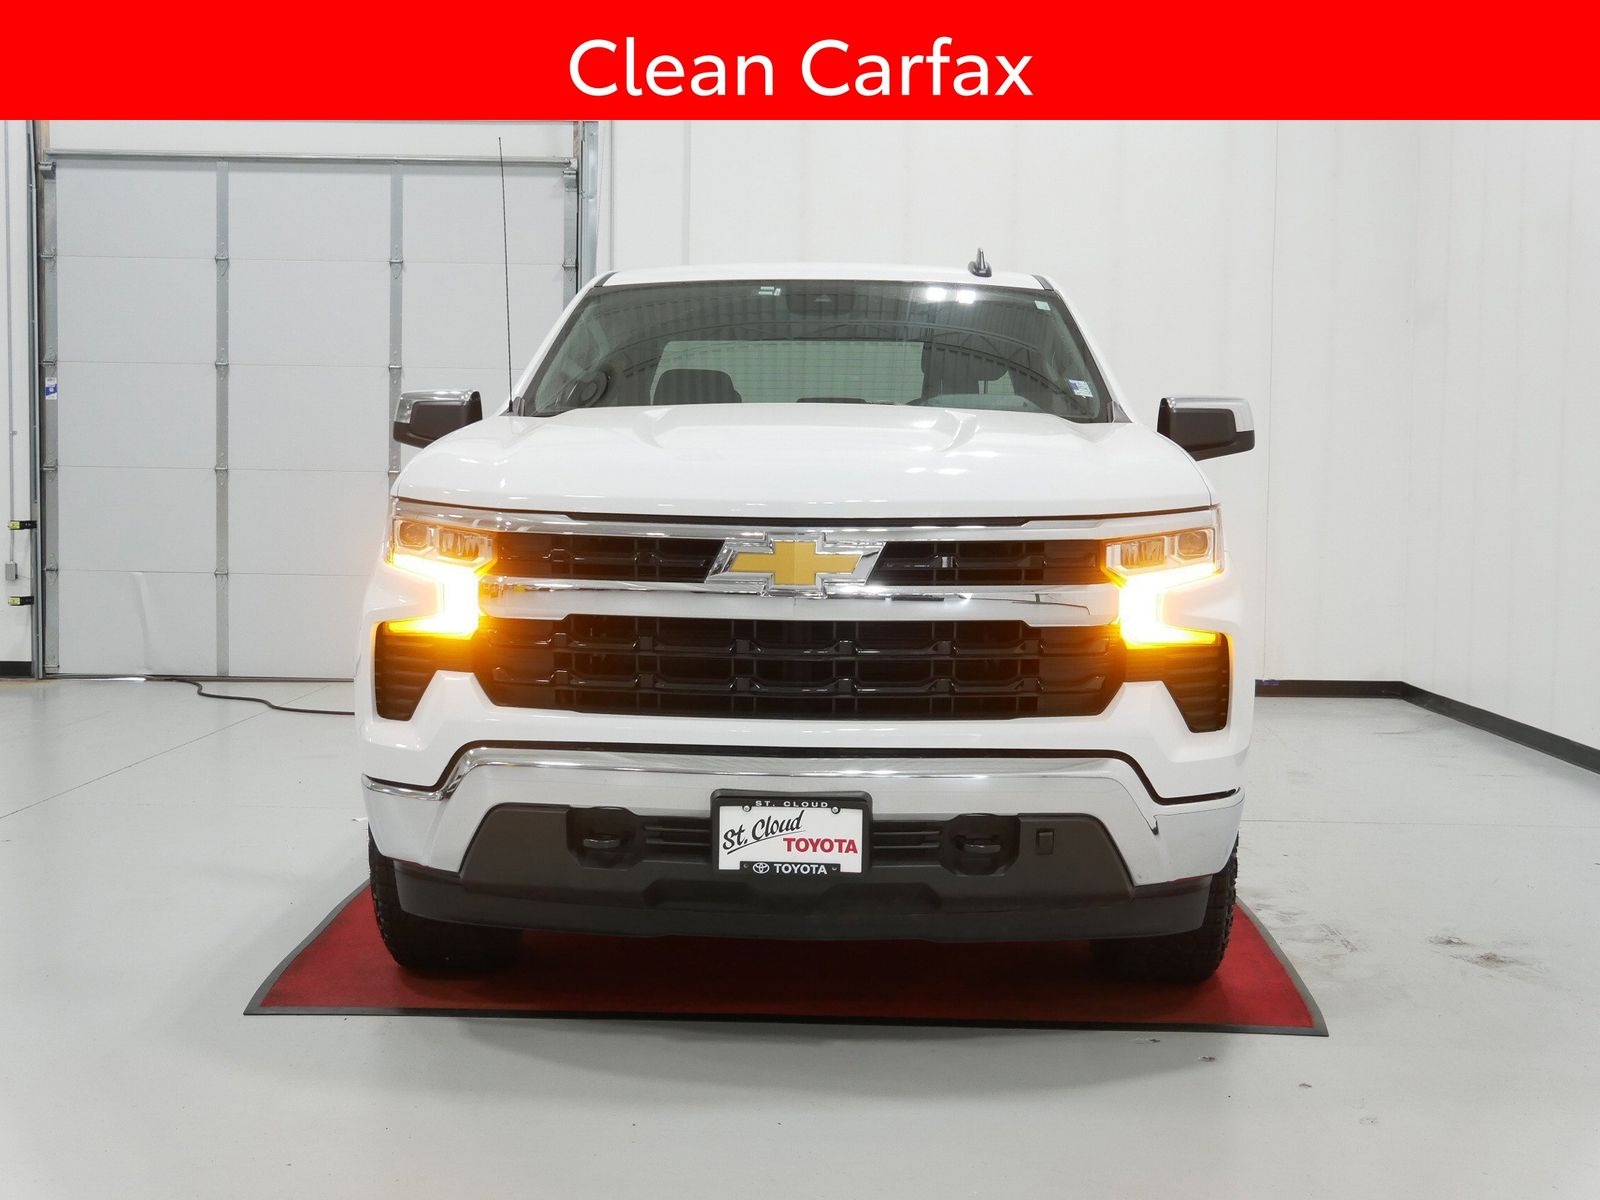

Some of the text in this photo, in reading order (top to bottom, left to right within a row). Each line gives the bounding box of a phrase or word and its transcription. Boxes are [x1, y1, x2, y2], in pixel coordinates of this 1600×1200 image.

[783, 800, 829, 808] CLOUD
[722, 809, 805, 850] St. Cloud
[783, 837, 859, 854] TOYOTA
[773, 863, 828, 875] TOYOTA
